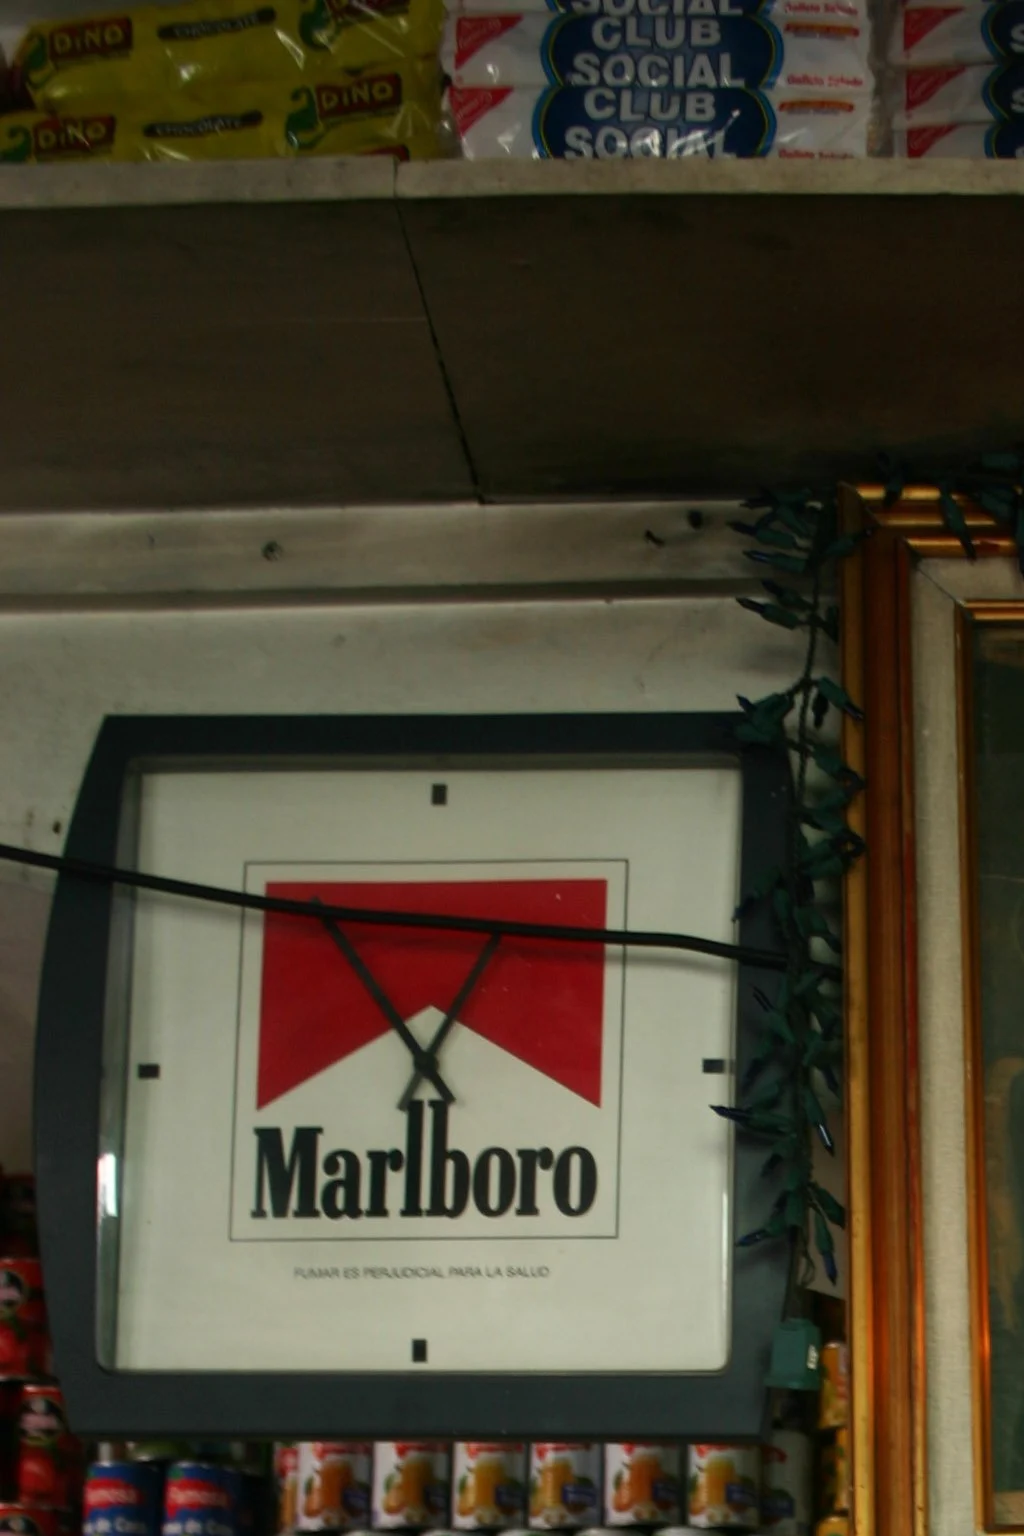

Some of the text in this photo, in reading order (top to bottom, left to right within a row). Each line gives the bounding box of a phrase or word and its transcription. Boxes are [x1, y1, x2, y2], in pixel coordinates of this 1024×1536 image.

[591, 15, 722, 51] CLUB
[568, 51, 746, 89] SOCIAL
[583, 88, 718, 123] CLUB
[564, 125, 739, 159] SOCIAL
[250, 1100, 599, 1219] Marlboro
[294, 1265, 549, 1279] FUMAR ES PERJUDICIAL PARA LA SALUD
